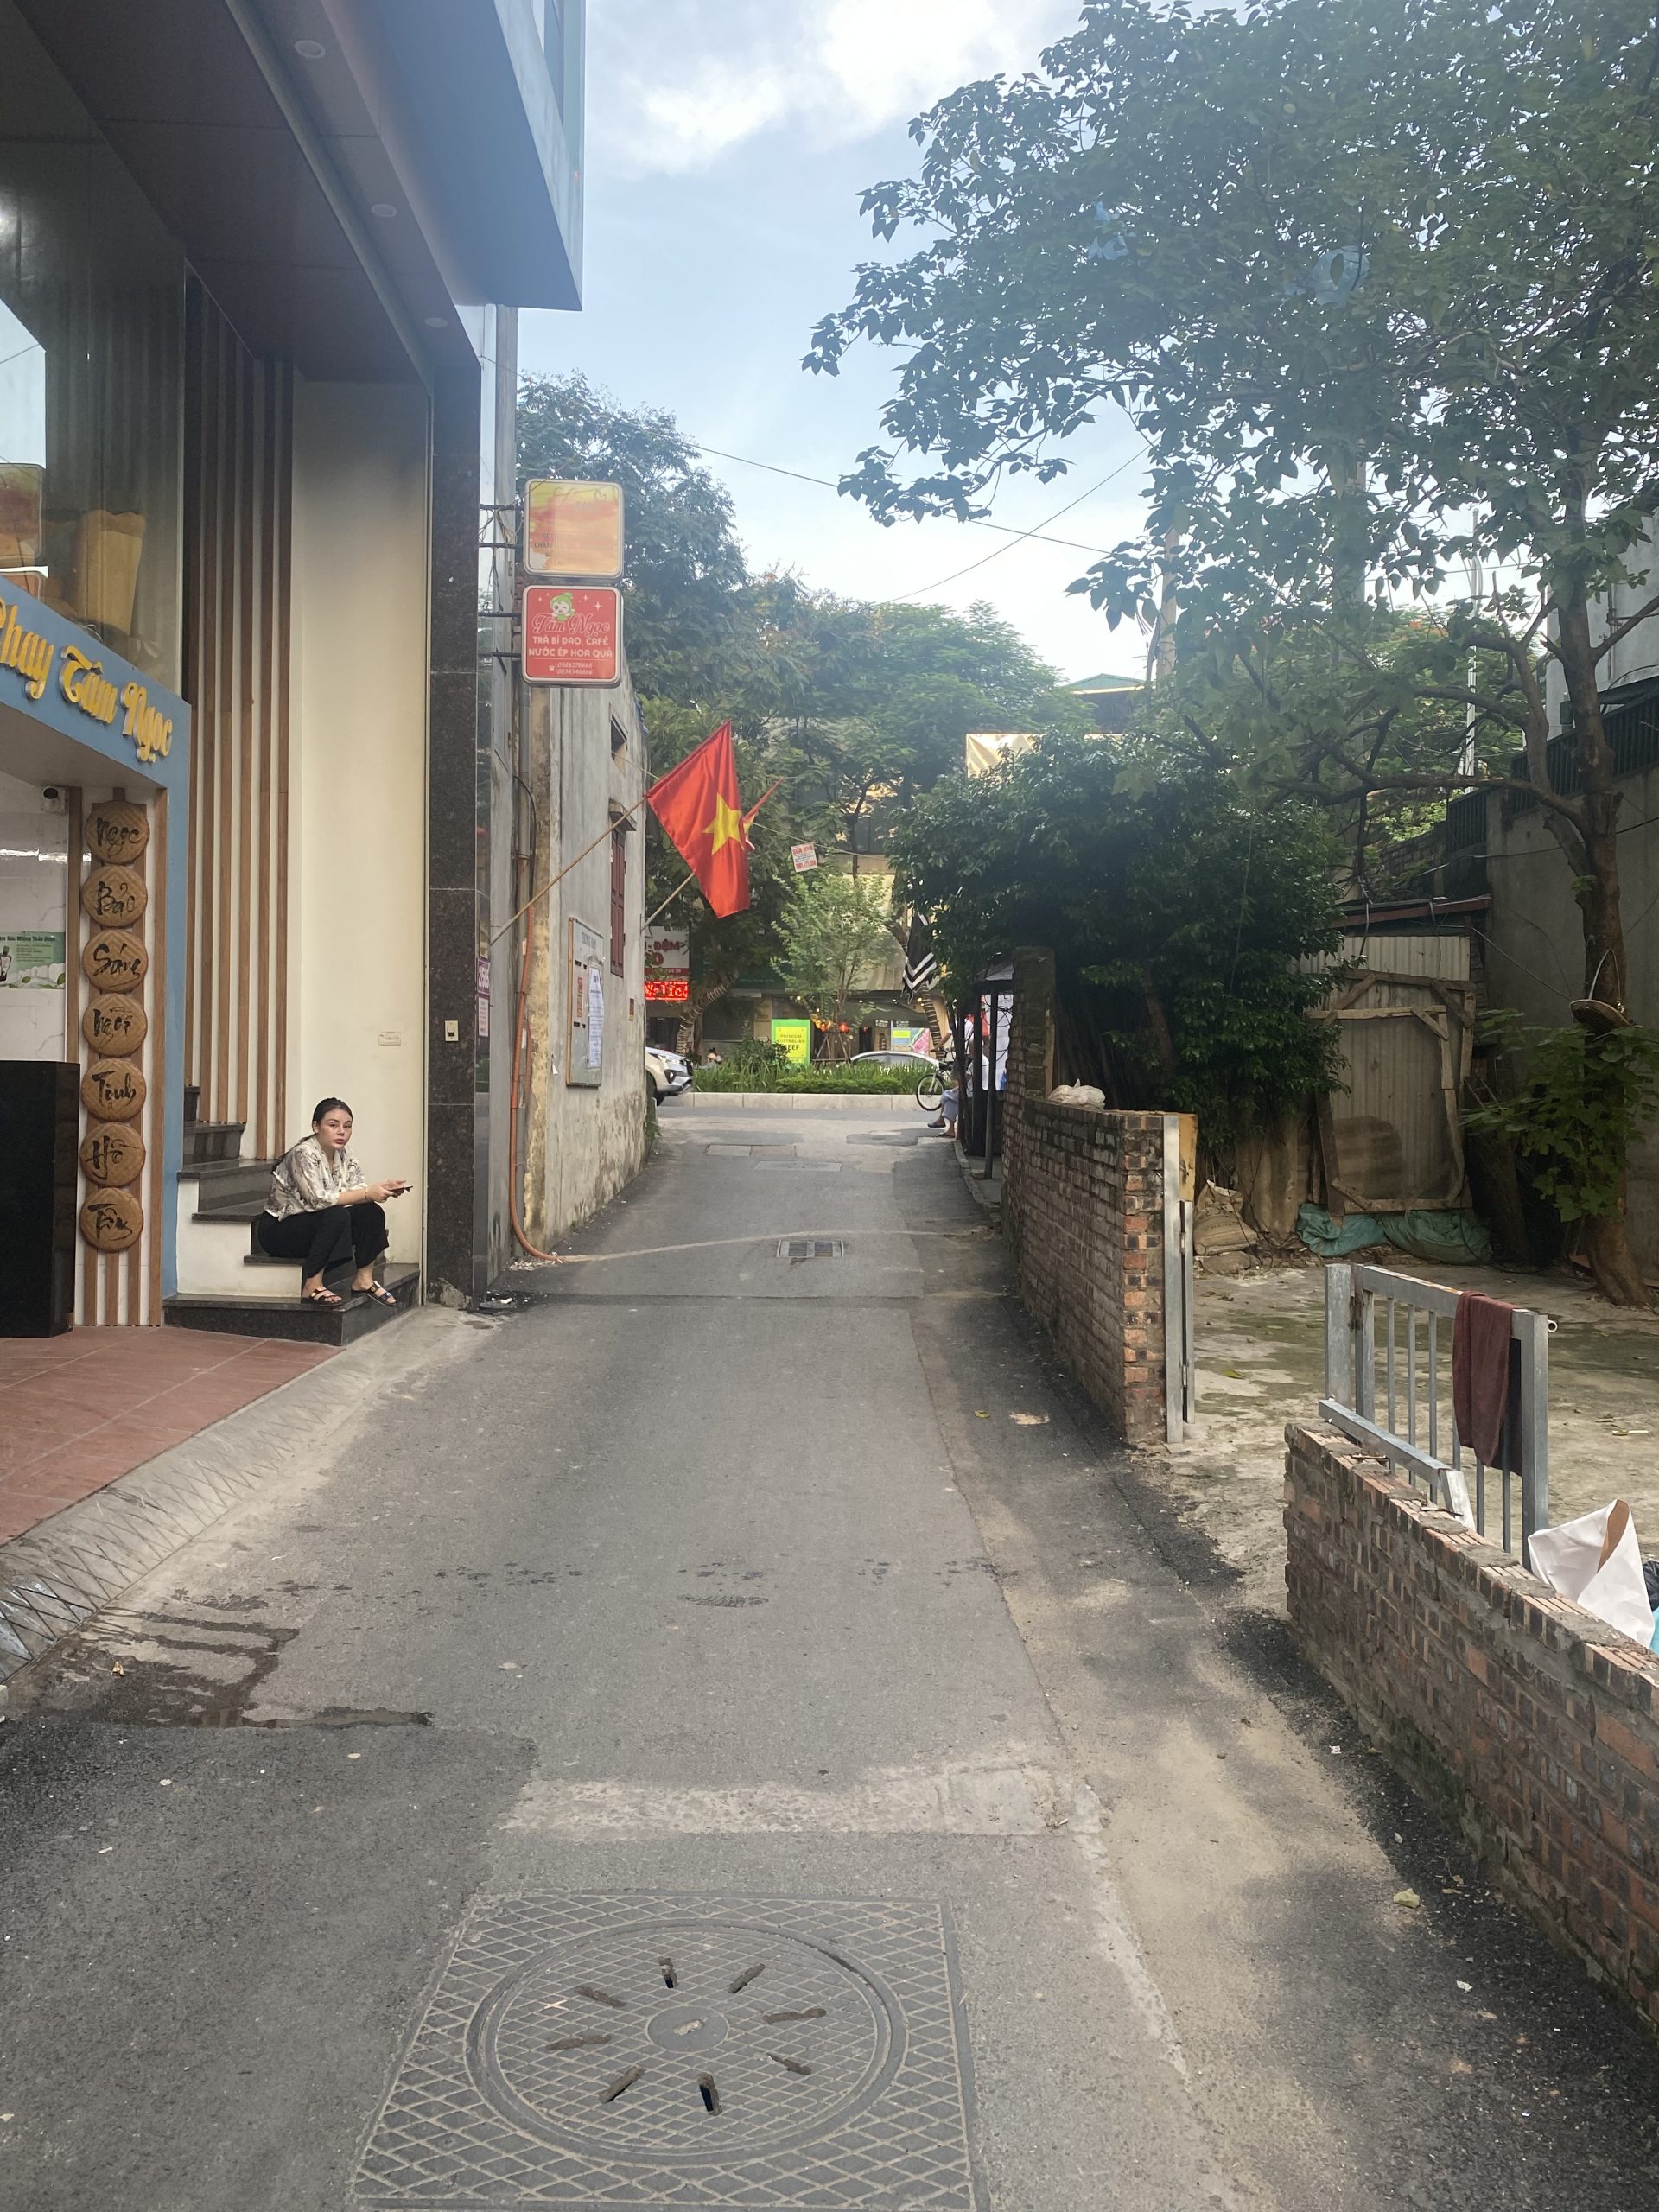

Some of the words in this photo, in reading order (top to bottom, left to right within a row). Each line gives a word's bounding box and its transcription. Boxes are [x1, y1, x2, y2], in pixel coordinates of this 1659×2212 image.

[567, 613, 610, 637] Ngọc
[532, 635, 549, 645] TRÀ
[551, 634, 560, 645] BÍ
[586, 635, 609, 645] CAFÉ
[528, 647, 555, 657] NƯỚC
[557, 647, 569, 657] ÉP
[571, 649, 590, 658] HOA
[592, 646, 613, 658] QUẢ
[96, 880, 136, 918] Bảo
[92, 942, 141, 988] Sáng
